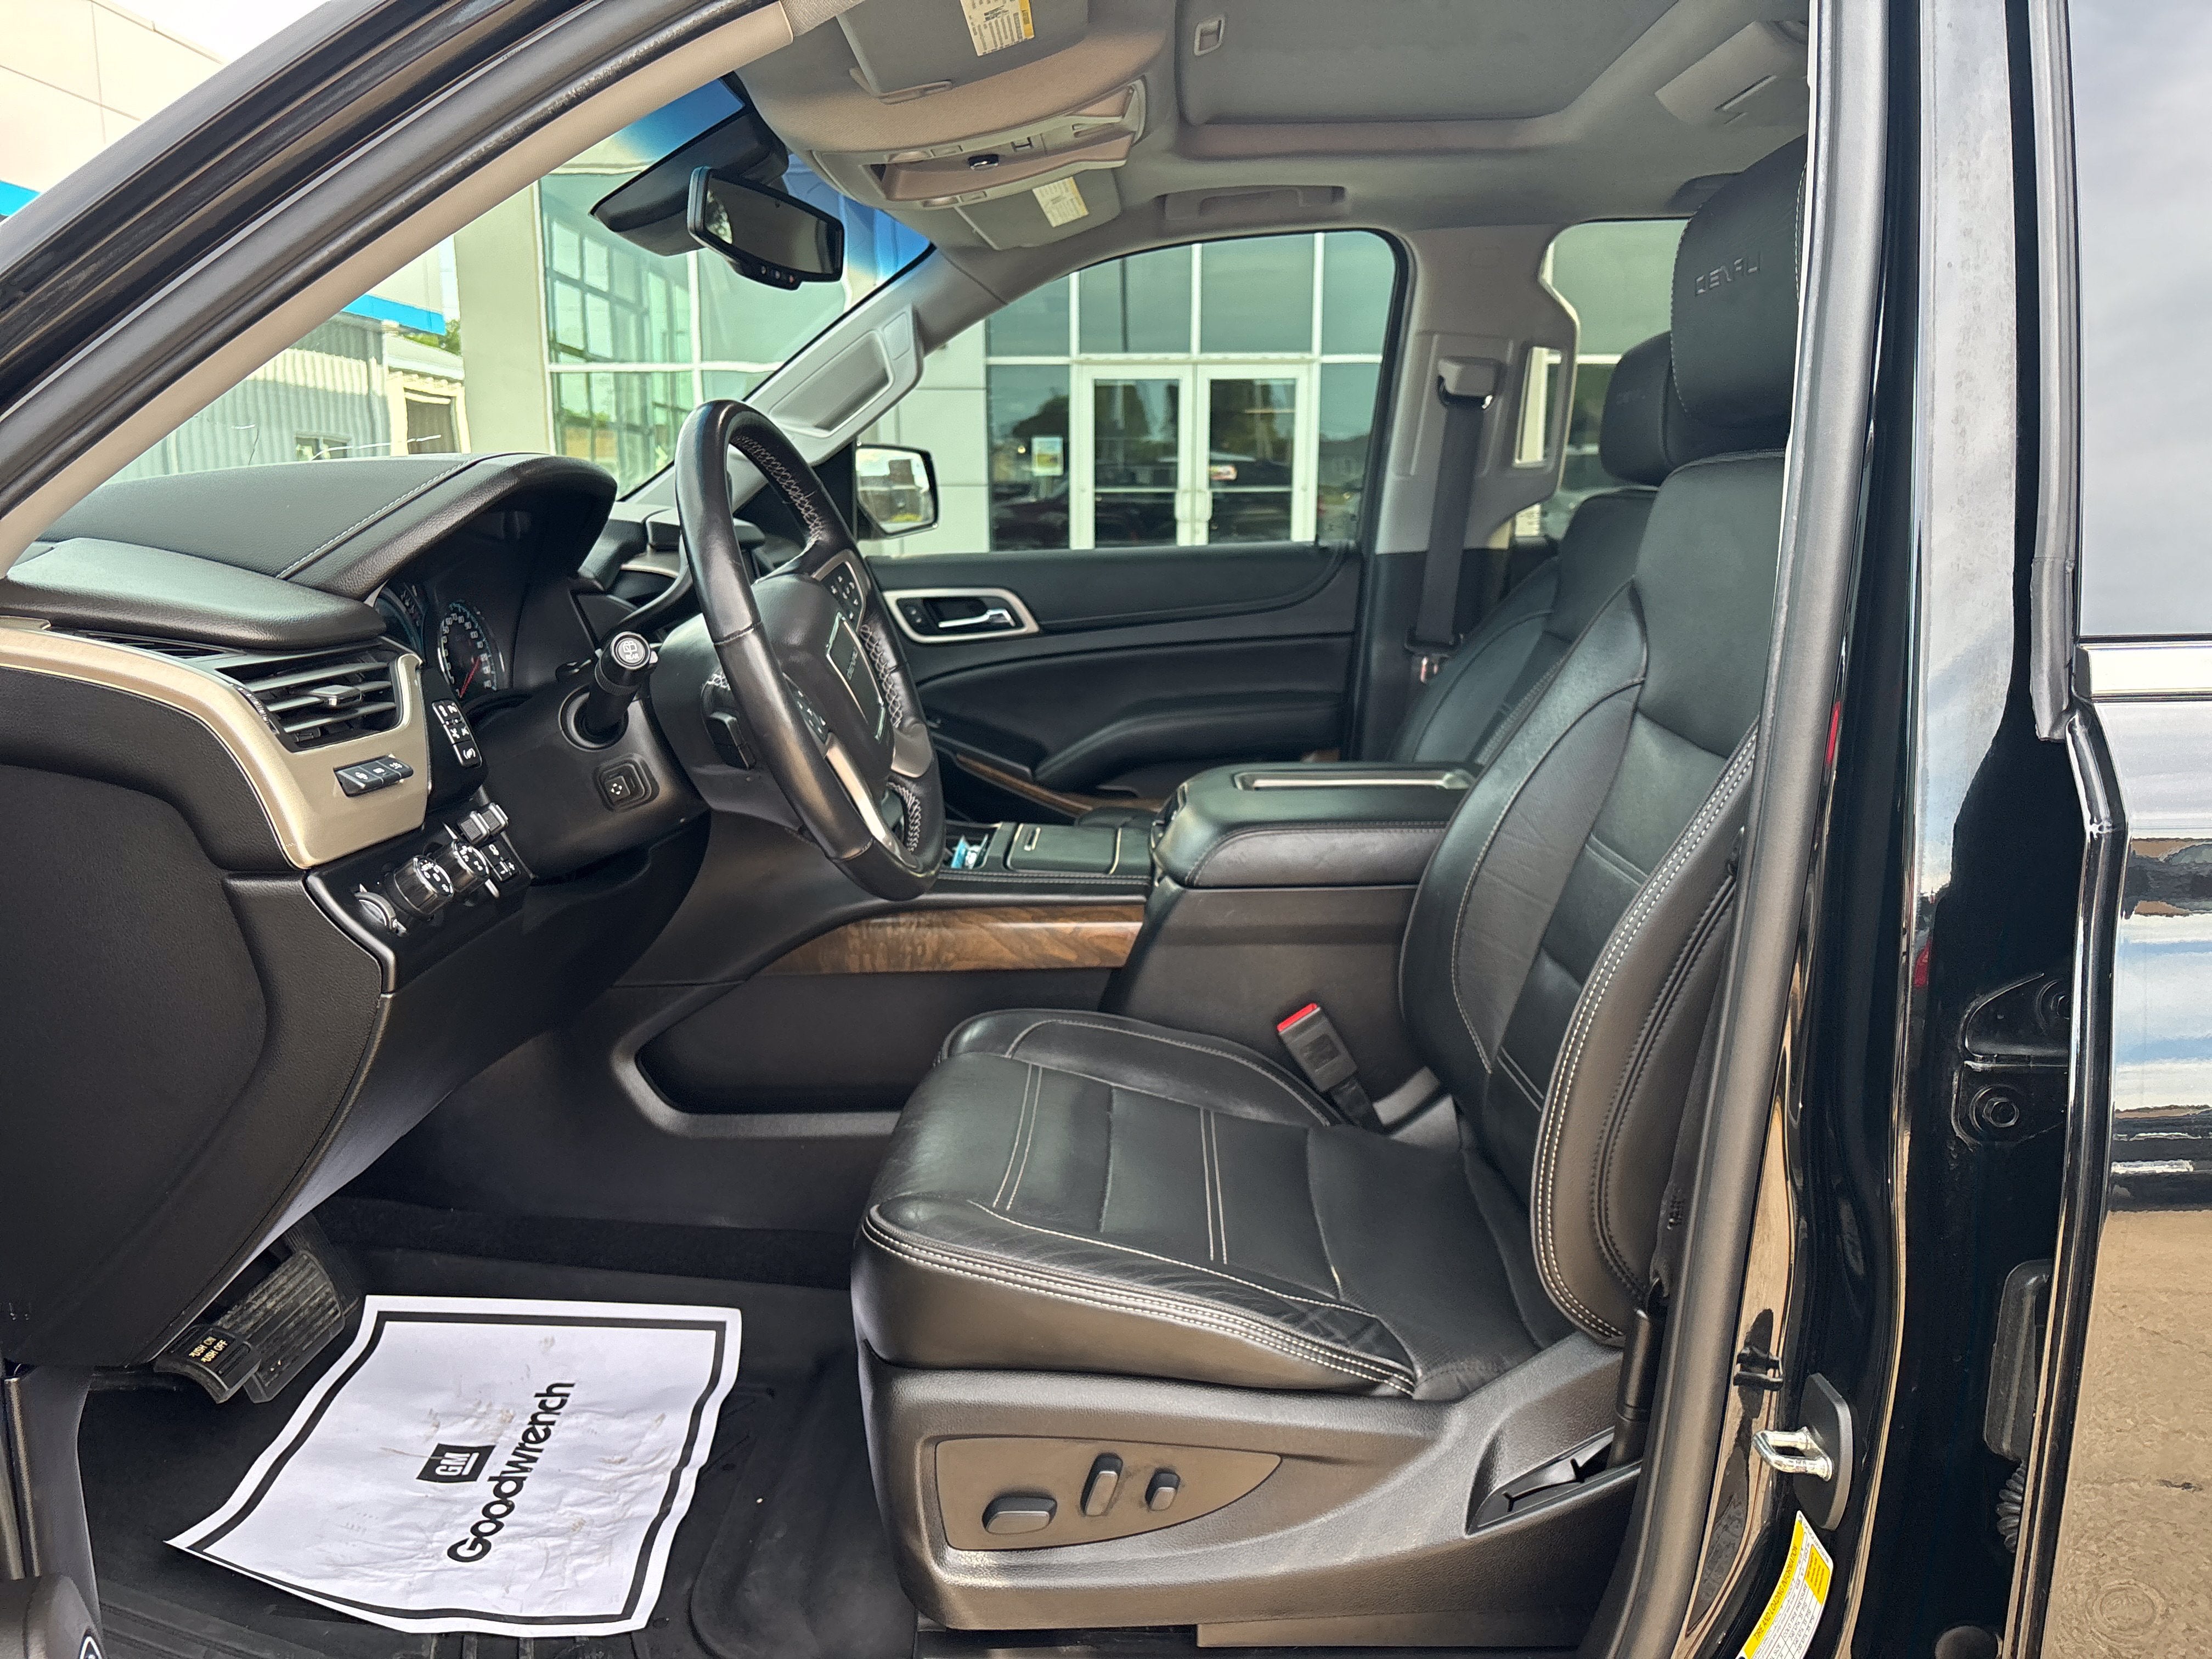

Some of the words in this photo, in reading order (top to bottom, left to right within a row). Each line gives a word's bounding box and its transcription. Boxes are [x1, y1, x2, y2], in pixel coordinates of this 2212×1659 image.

[1694, 251, 1762, 297] DENALI
[213, 1339, 228, 1351] OFF
[435, 1452, 471, 1476] GM
[447, 1382, 575, 1563] Goodwrench
